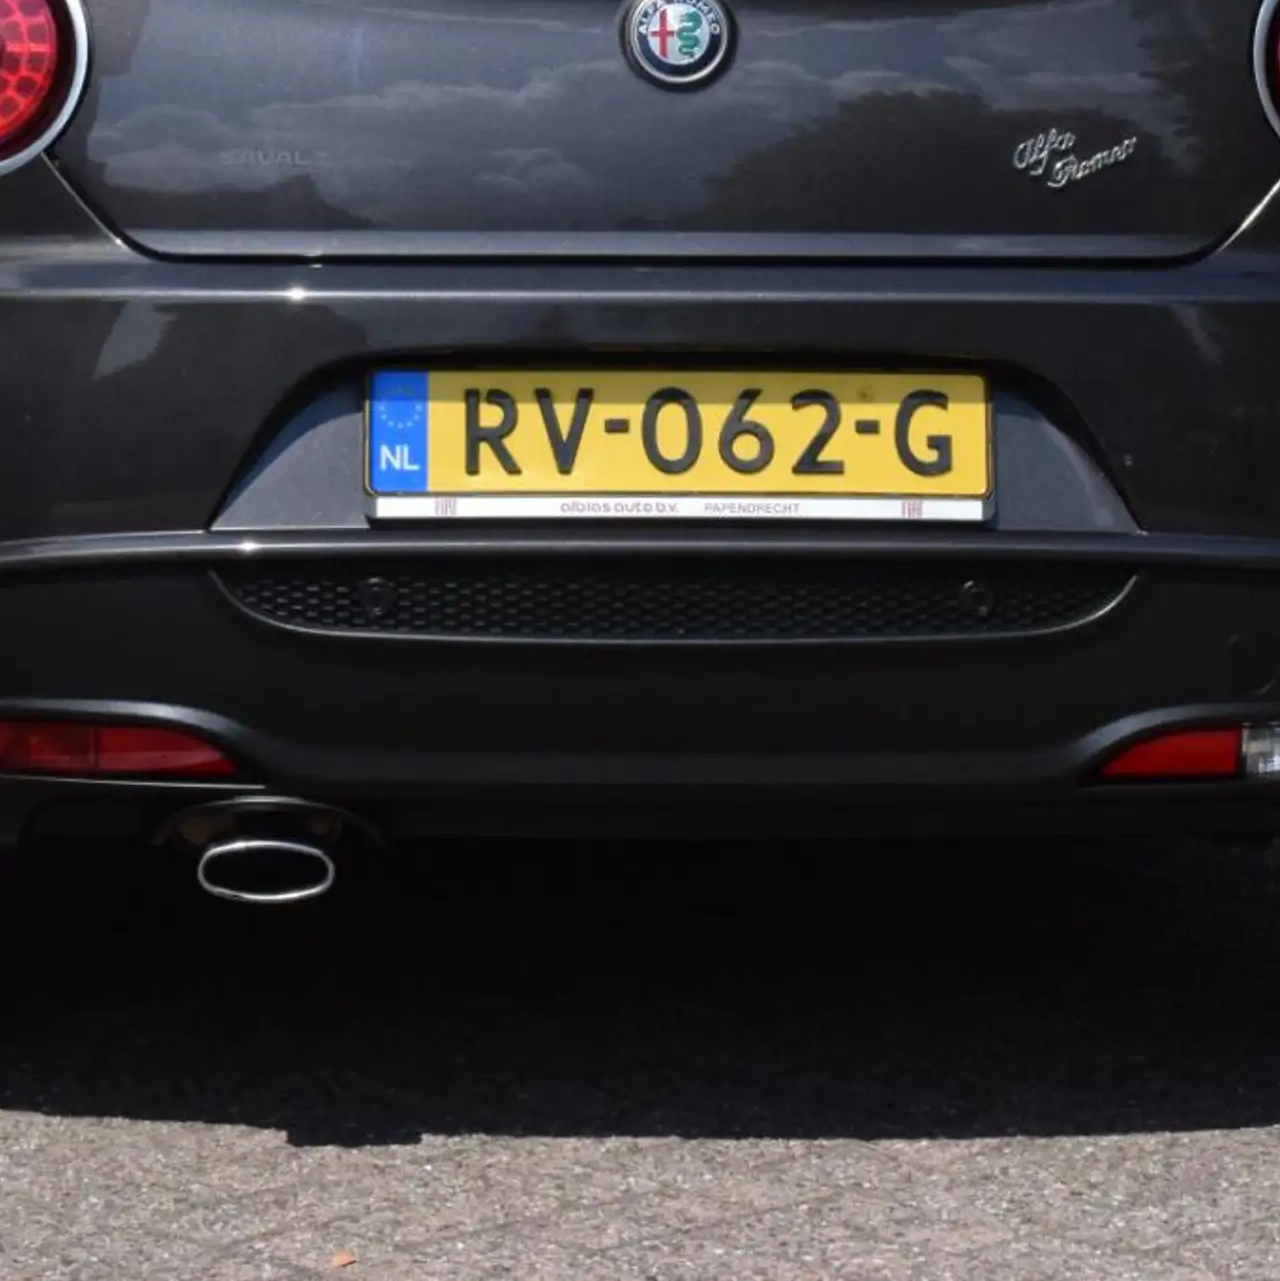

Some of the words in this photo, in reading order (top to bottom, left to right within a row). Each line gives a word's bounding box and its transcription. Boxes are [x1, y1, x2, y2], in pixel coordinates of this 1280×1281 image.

[1013, 127, 1076, 176] Alfa
[1047, 135, 1138, 188] Romeo
[464, 386, 953, 477] RV-062-G
[379, 442, 421, 471] NL
[613, 501, 653, 515] auto
[703, 501, 801, 515] PAPENDRECHT
